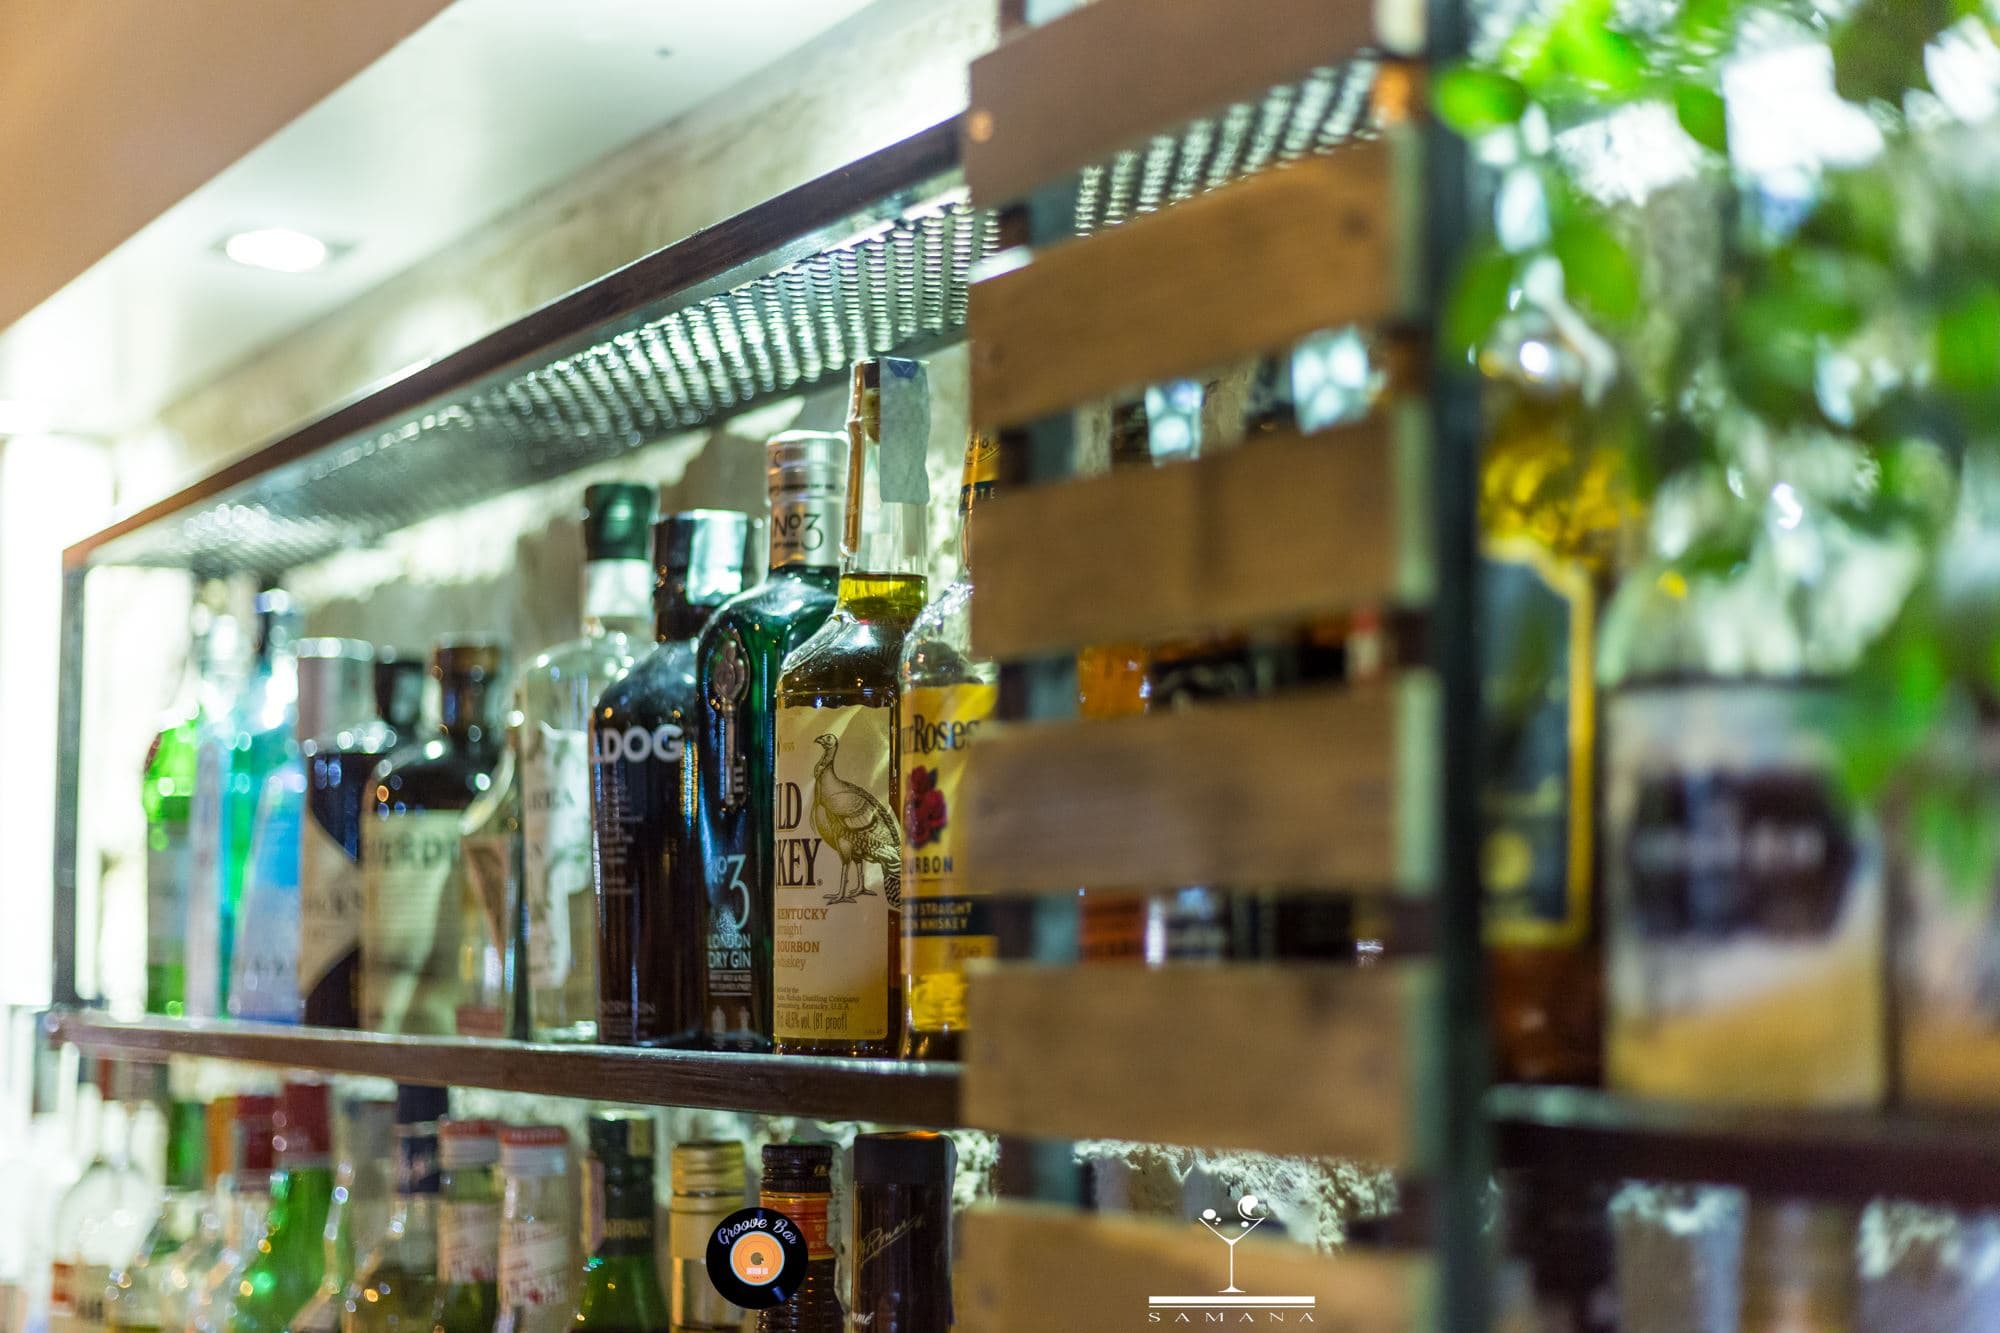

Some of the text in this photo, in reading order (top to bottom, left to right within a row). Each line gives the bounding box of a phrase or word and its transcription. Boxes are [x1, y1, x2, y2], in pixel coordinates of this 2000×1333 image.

[776, 781, 803, 830] LD
[776, 838, 823, 887] KEY
[708, 951, 752, 969] DRY GIN
